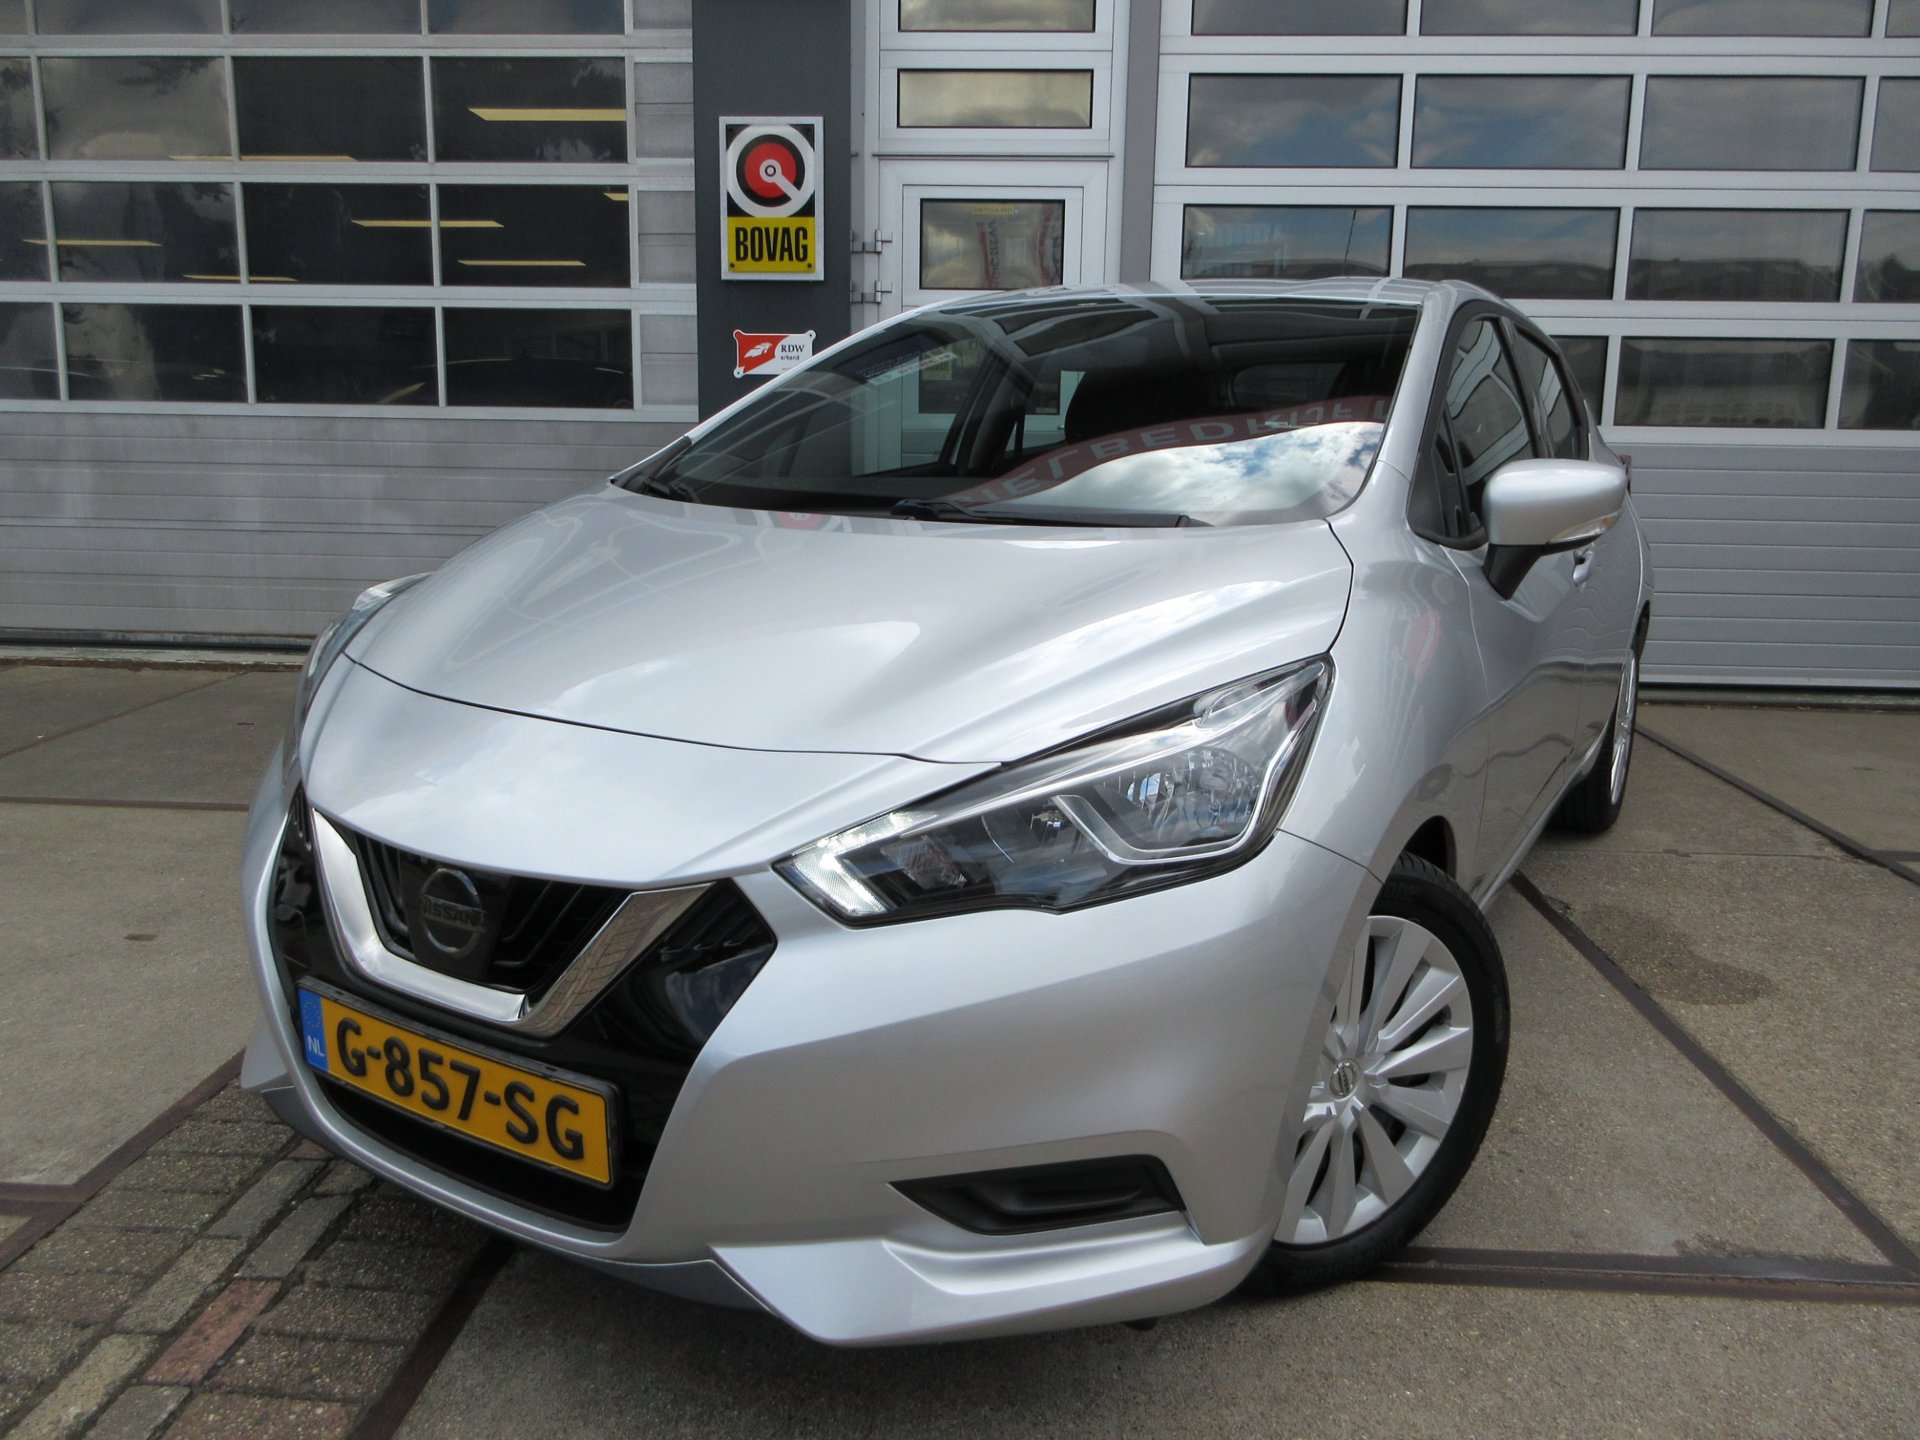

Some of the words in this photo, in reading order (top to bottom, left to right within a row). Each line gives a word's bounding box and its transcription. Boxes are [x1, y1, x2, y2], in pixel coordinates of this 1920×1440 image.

[735, 226, 808, 262] BOVAG
[781, 344, 805, 352] RDW
[307, 1035, 325, 1057] NL
[336, 1017, 584, 1161] G-857-SG
